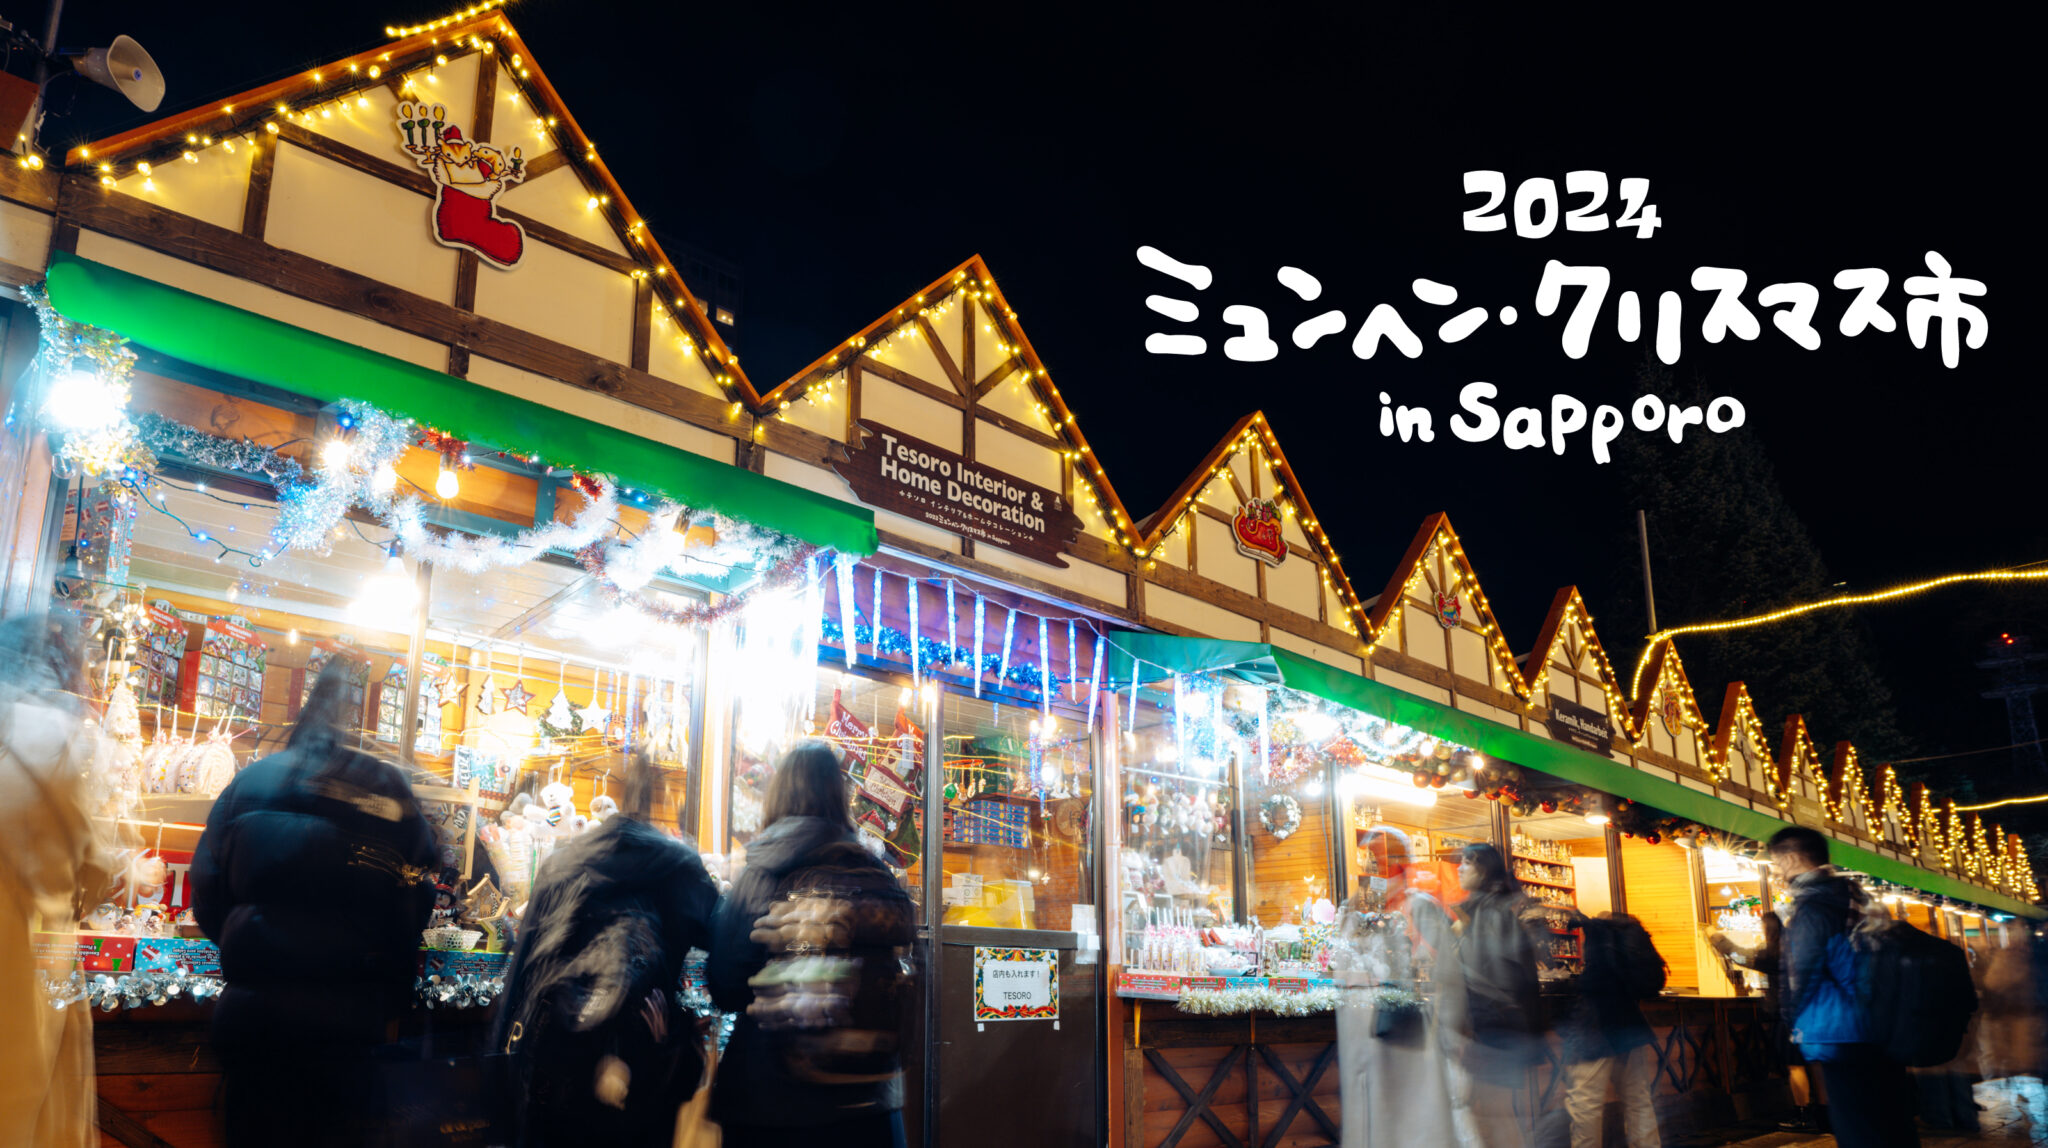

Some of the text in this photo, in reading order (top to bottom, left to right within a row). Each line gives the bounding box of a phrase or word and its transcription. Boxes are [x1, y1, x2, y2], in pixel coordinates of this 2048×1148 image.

[881, 433, 1044, 513] Tesoro Interior &
[881, 456, 1046, 533] Home Decoration
[1003, 991, 1032, 1000] TESORO
